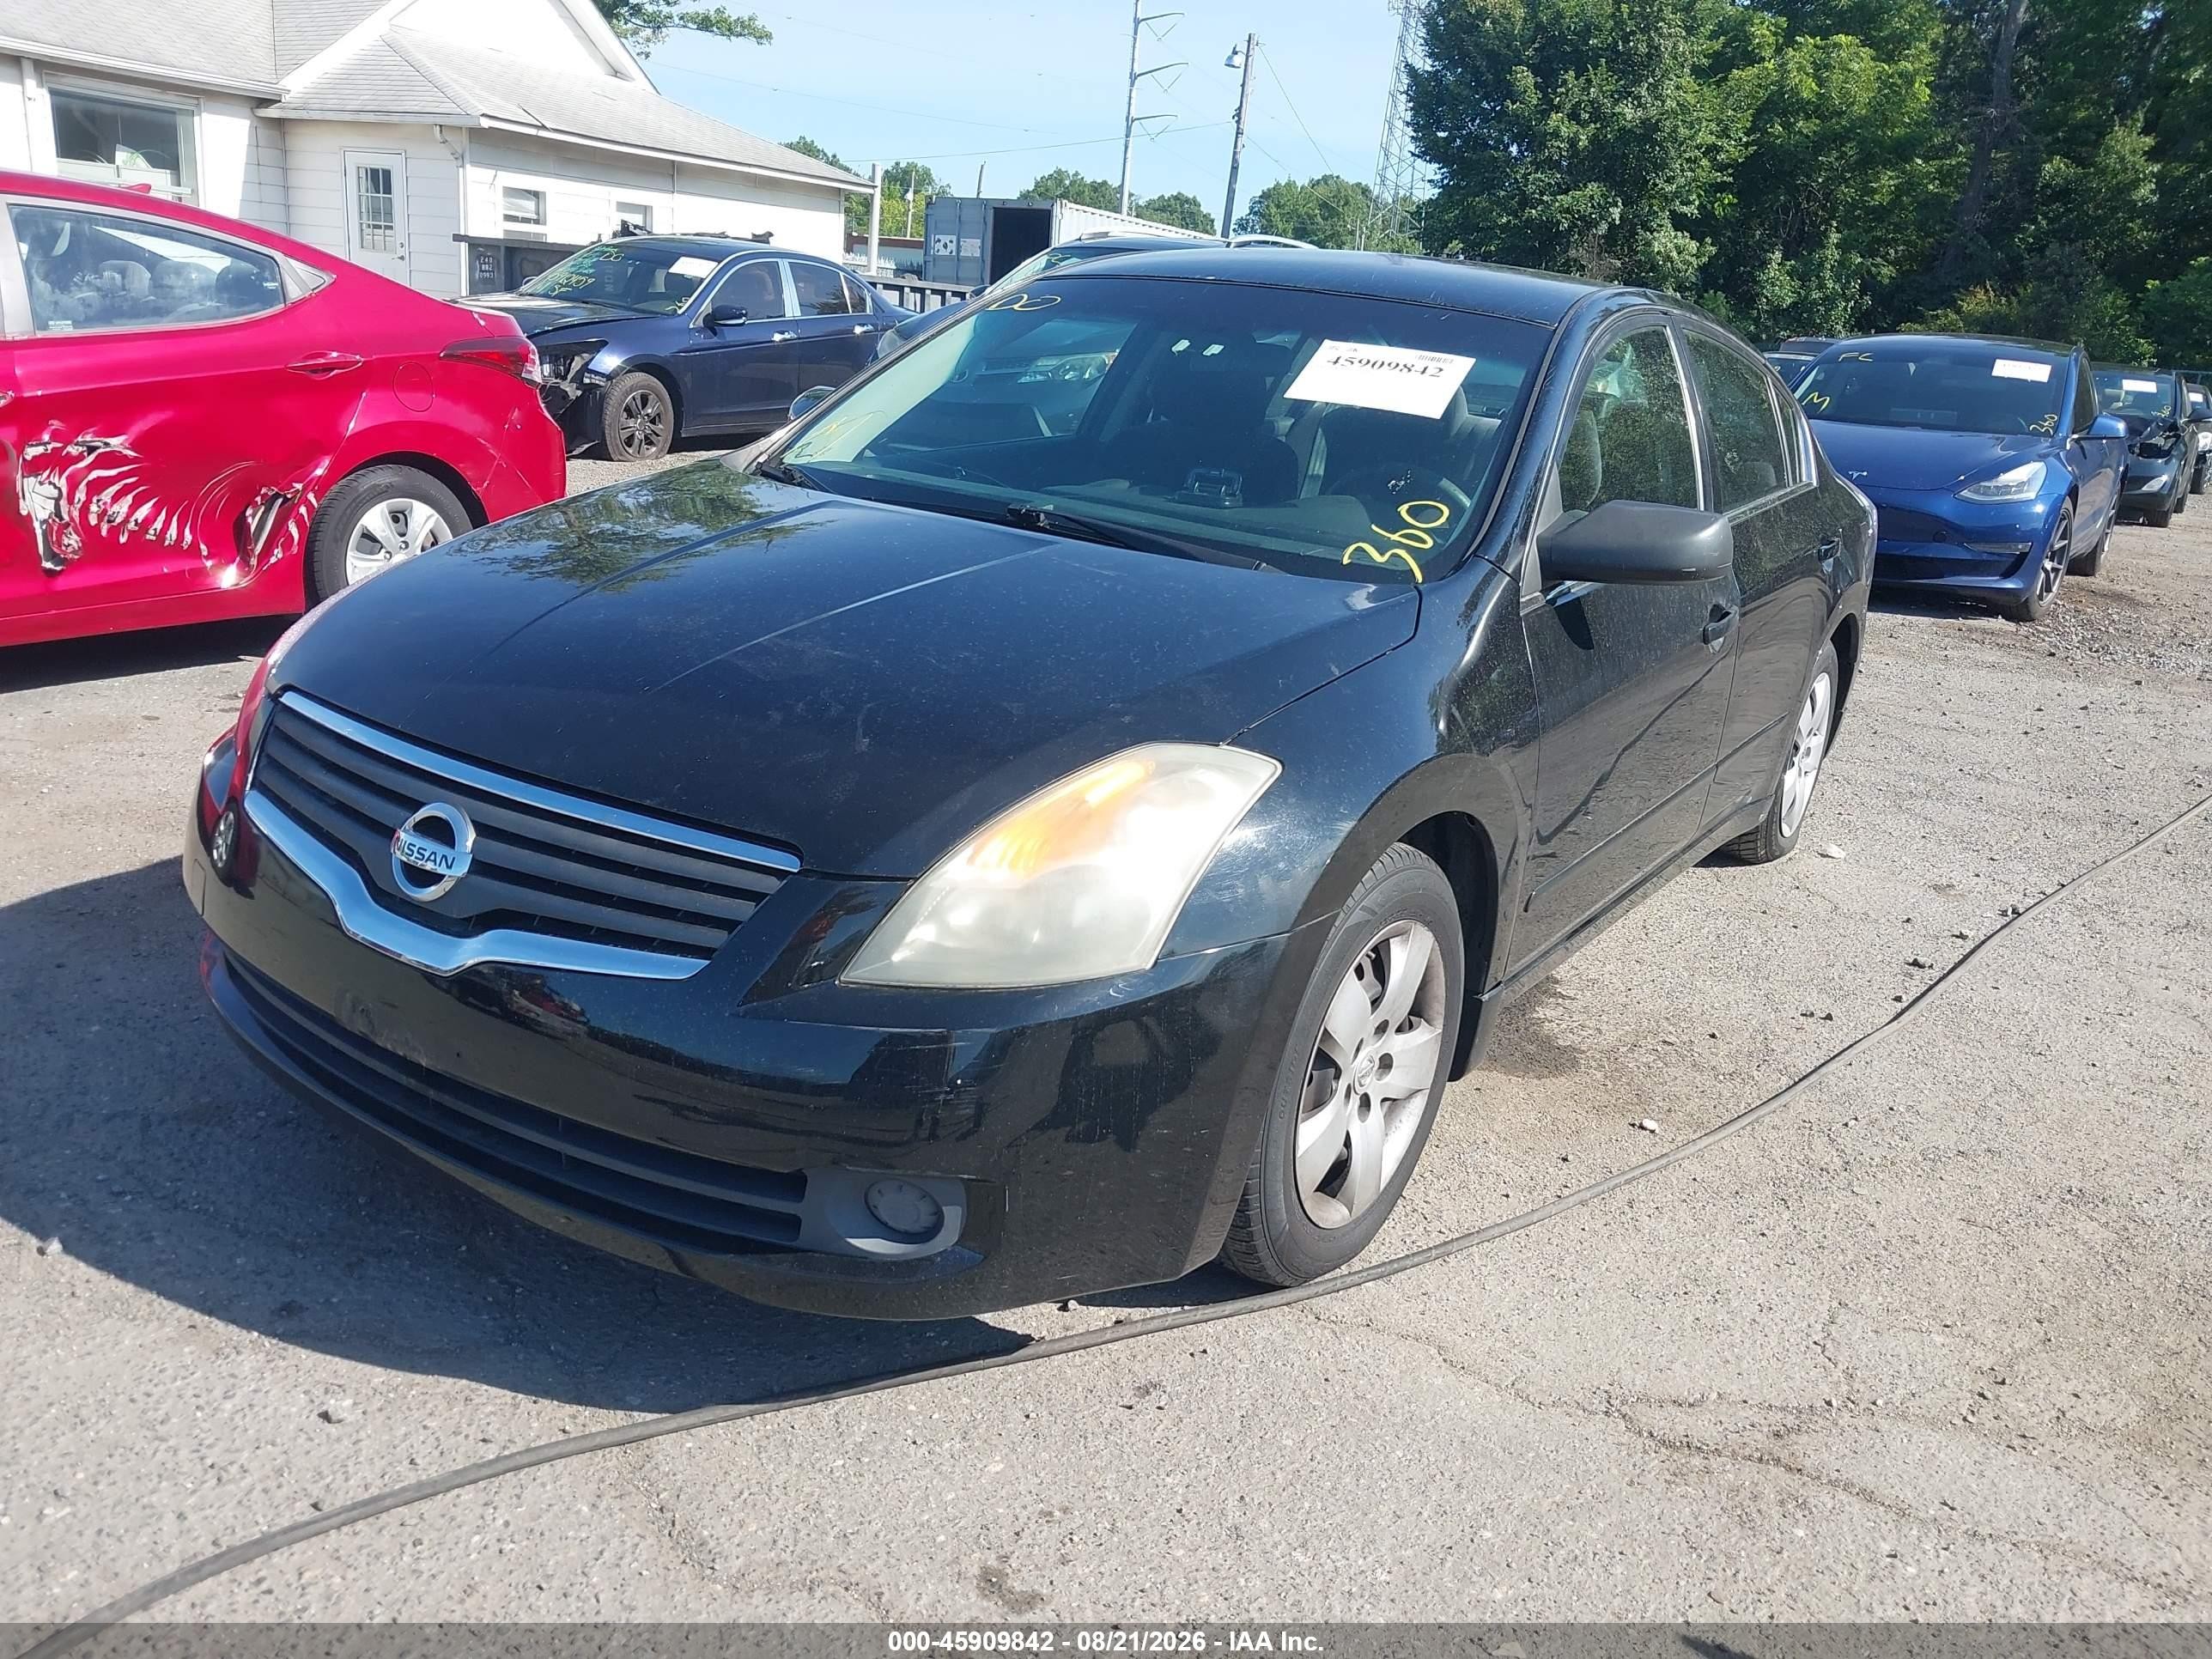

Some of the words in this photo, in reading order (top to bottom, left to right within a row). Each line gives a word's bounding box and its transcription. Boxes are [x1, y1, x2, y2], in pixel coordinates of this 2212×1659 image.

[1327, 355, 1444, 379] 45909842
[2029, 414, 2058, 436] 360
[1341, 500, 1450, 585] 360
[397, 838, 456, 871] NISSAN
